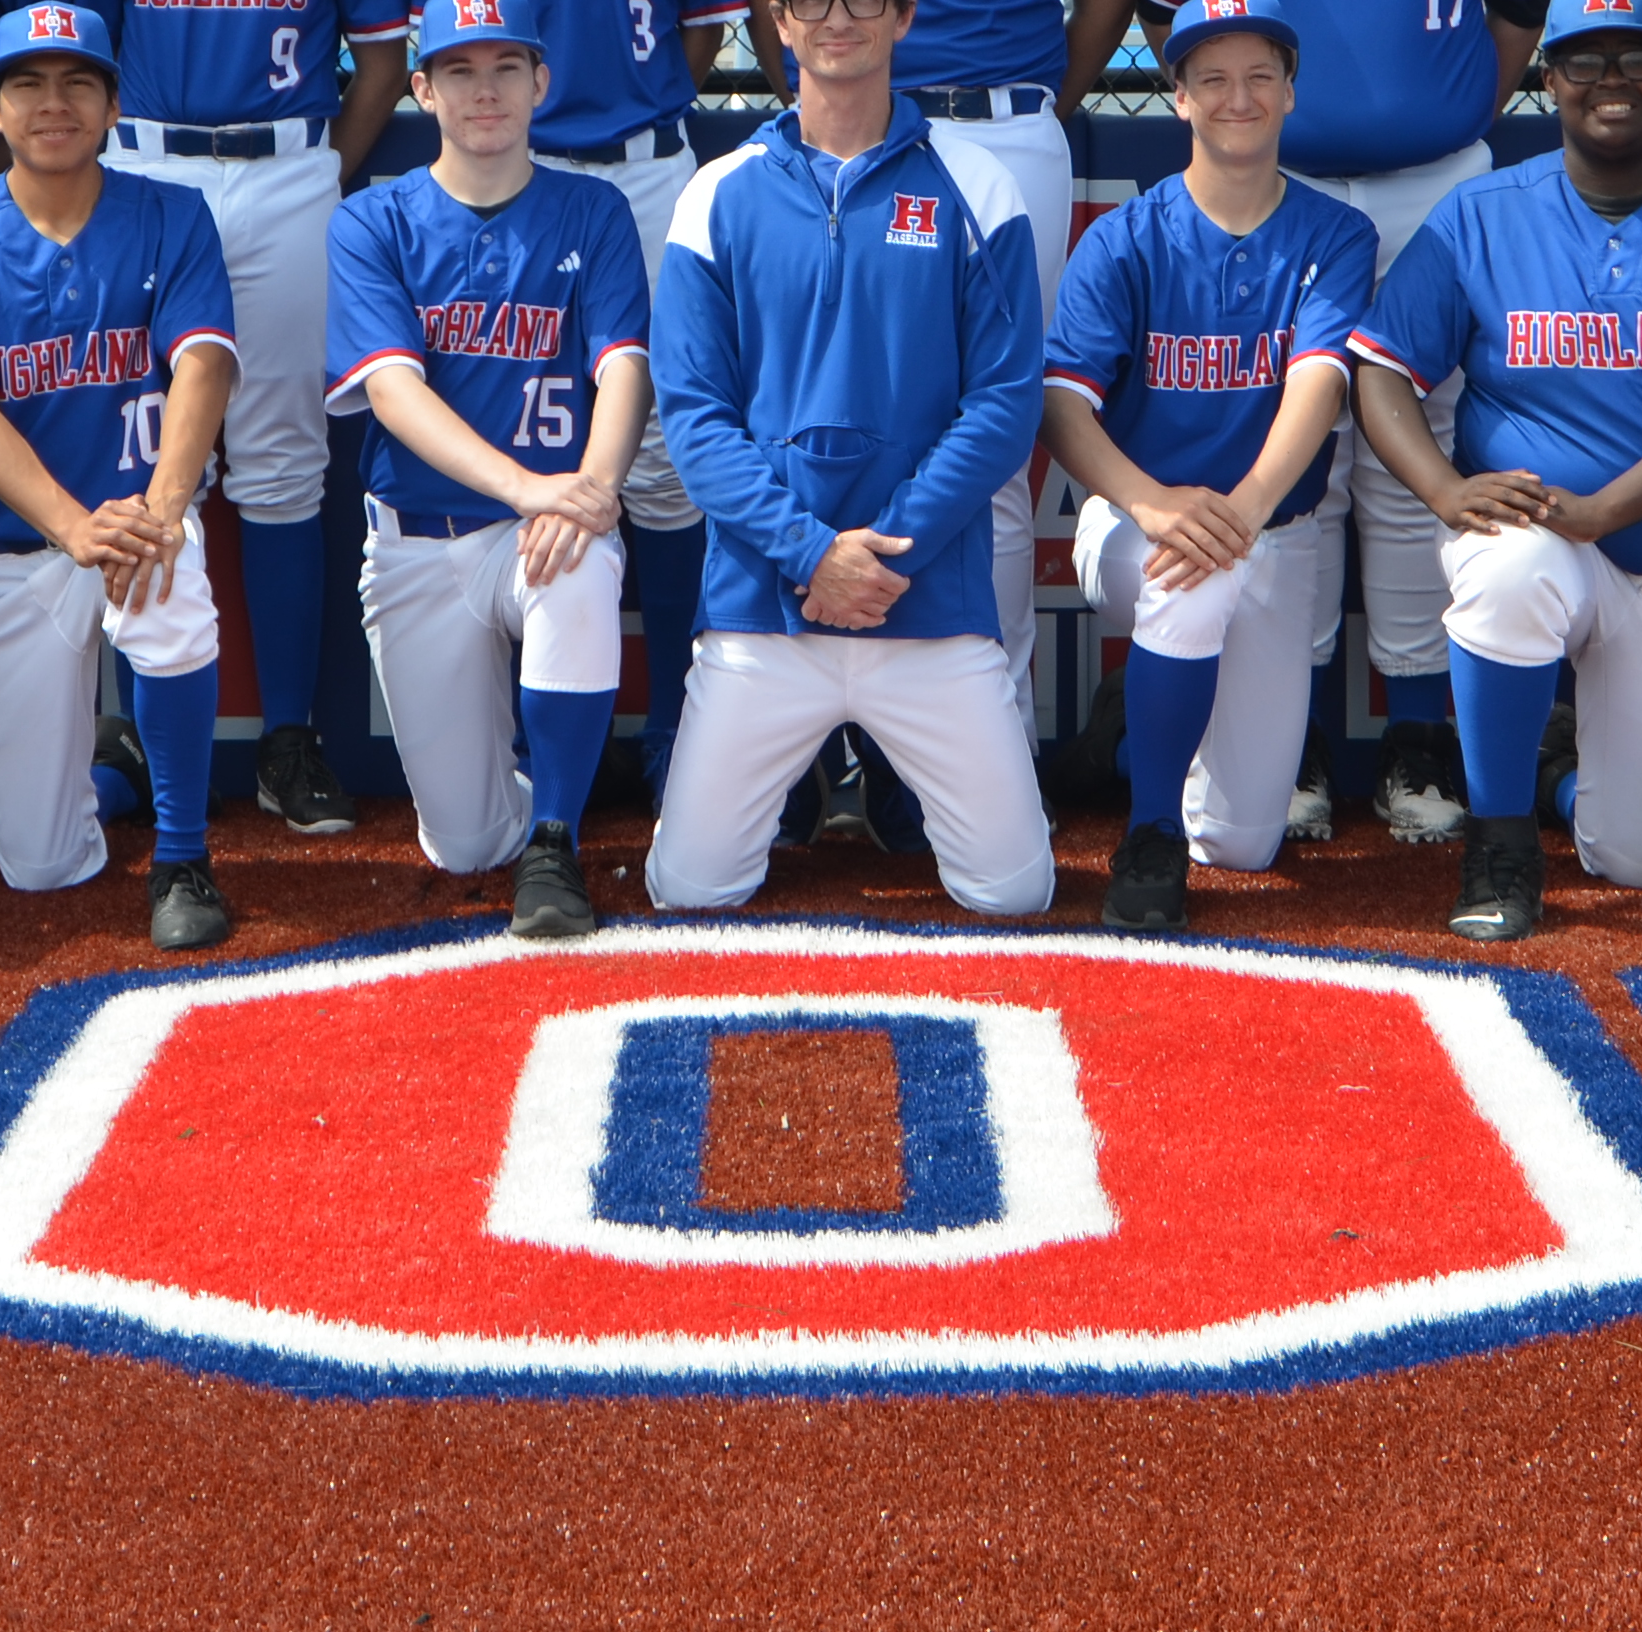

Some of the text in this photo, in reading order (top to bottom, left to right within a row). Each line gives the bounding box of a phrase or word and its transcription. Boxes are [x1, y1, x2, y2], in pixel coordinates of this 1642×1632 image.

[28, 5, 79, 41] H
[268, 26, 302, 91] 9
[885, 231, 938, 248] BASEBALL
[889, 192, 940, 235] H
[117, 392, 168, 472] 10
[512, 376, 575, 449] 15
